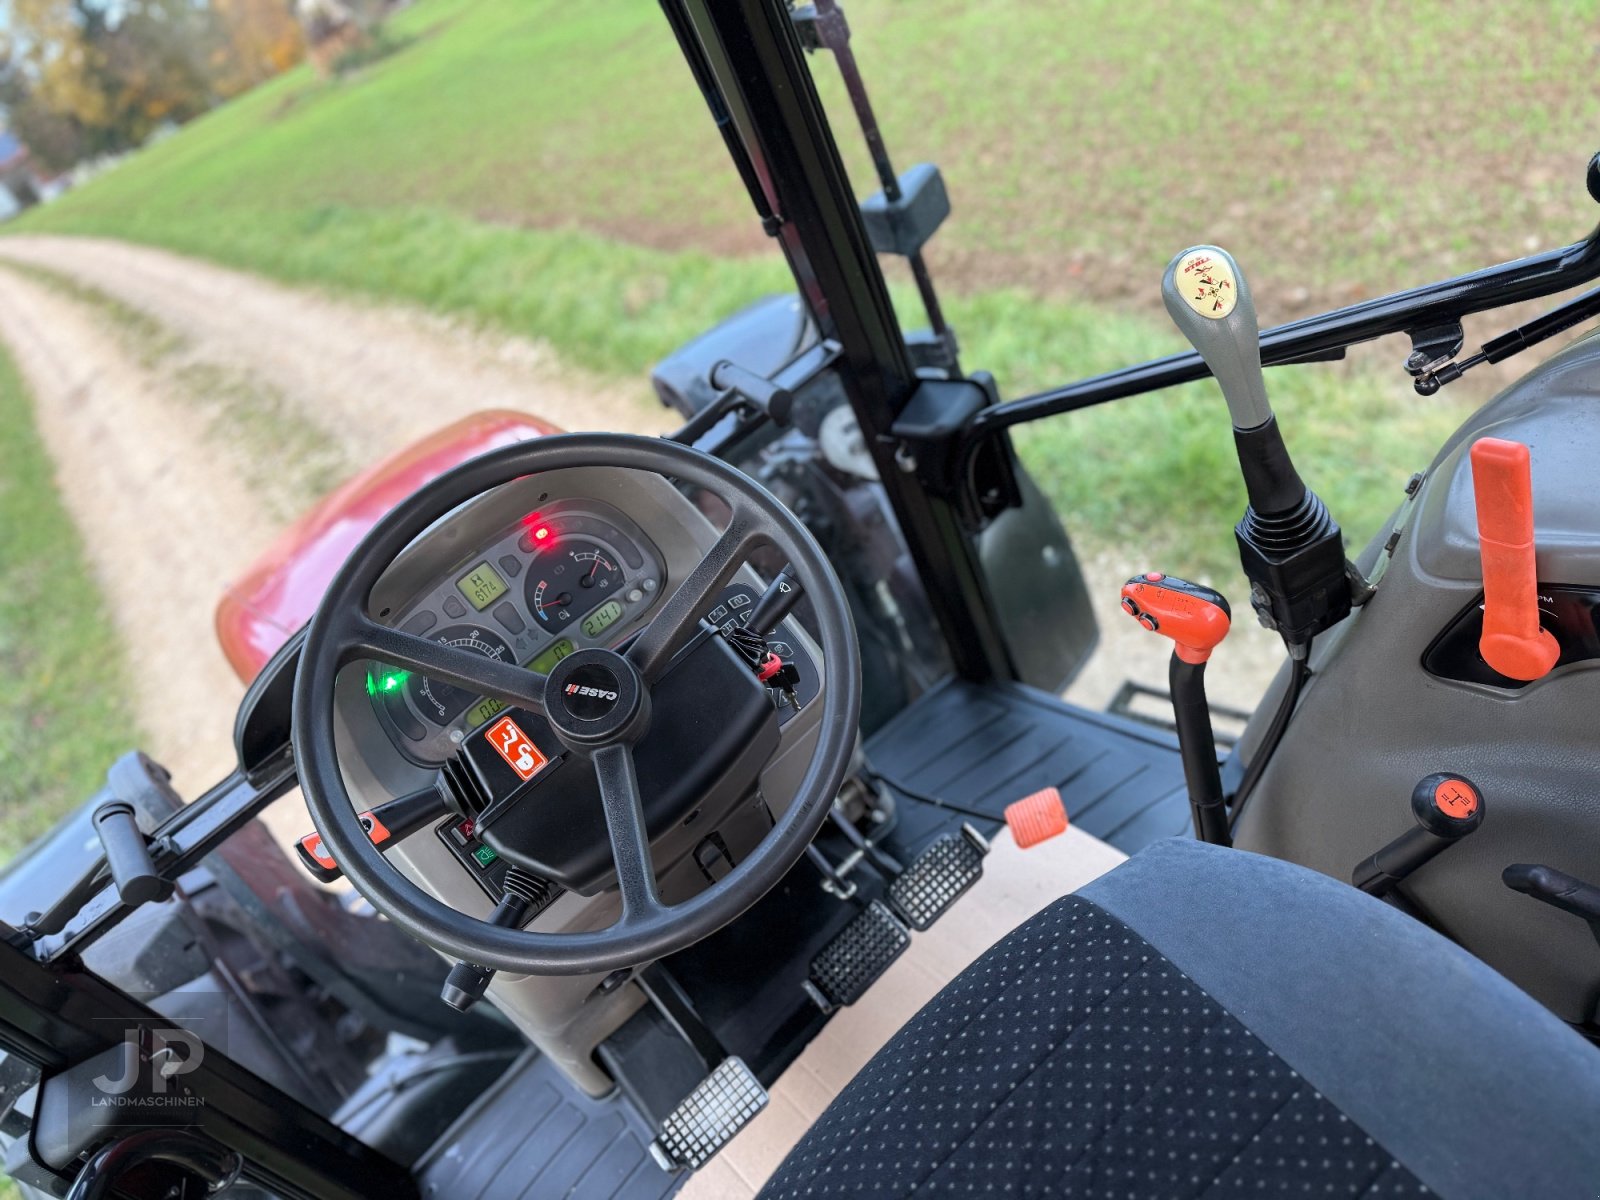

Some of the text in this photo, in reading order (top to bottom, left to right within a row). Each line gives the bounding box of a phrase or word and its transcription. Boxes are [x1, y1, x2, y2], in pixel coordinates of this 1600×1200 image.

[475, 581, 497, 602] 6174
[585, 603, 619, 635] 2141
[469, 629, 480, 639] 20
[495, 644, 505, 654] 25
[579, 688, 618, 701] CASE
